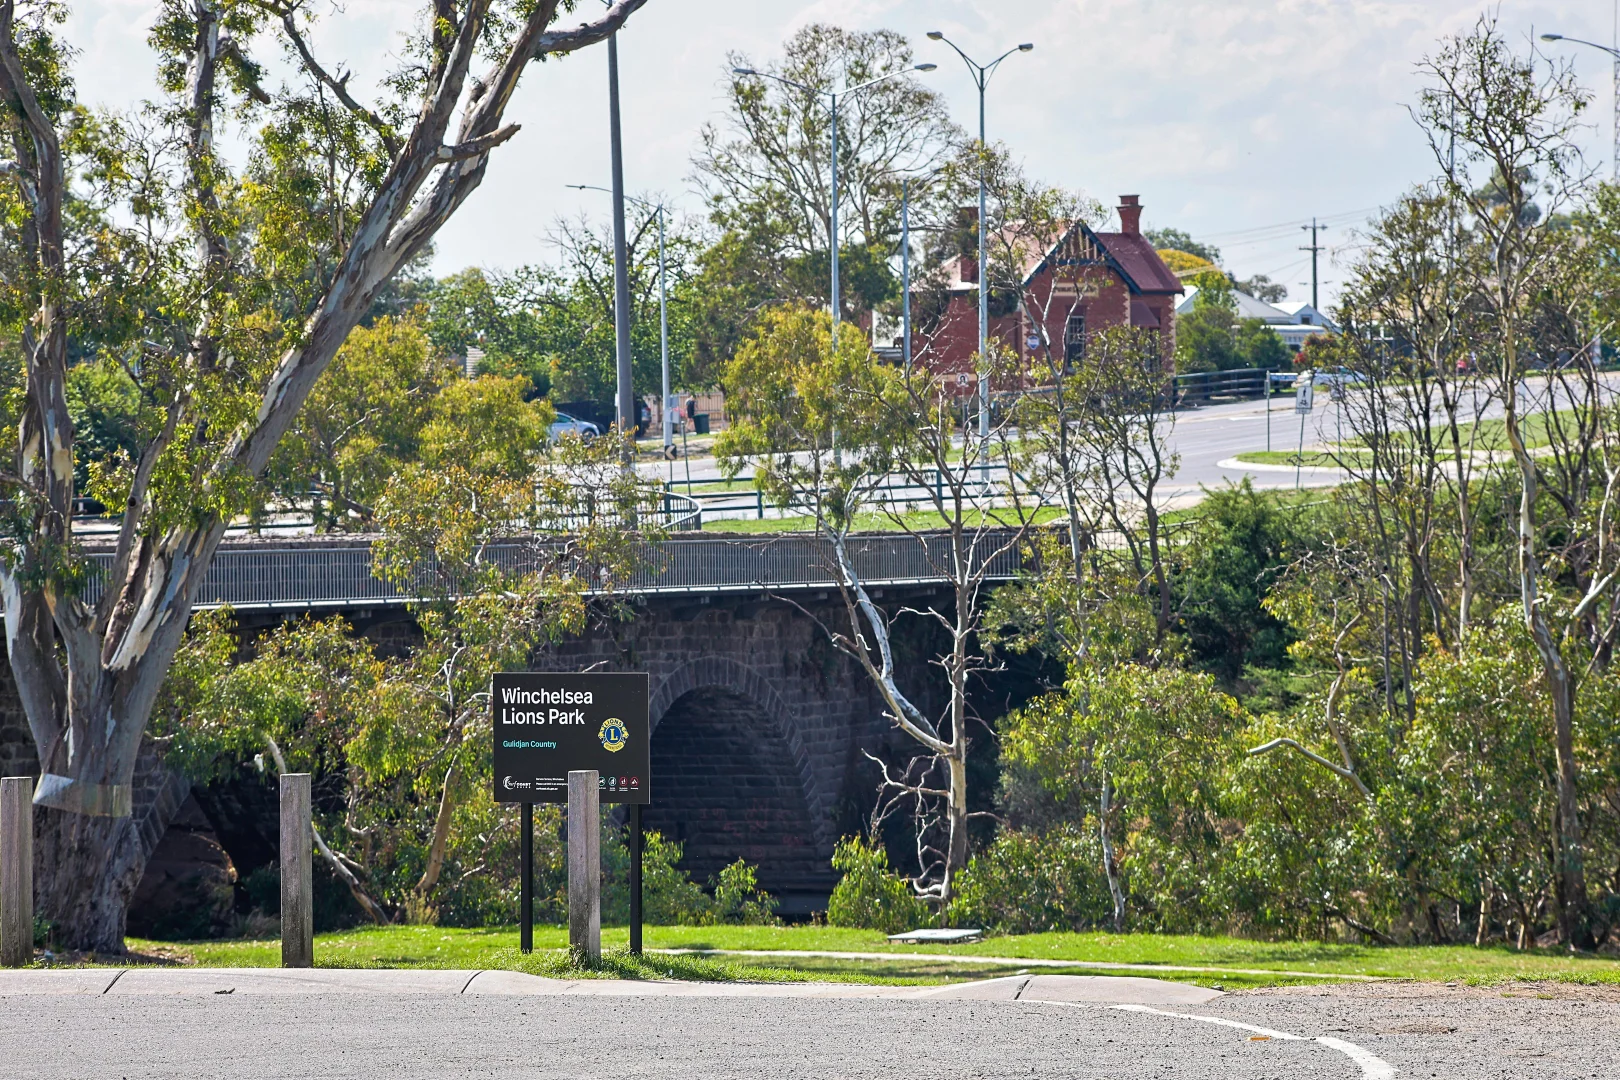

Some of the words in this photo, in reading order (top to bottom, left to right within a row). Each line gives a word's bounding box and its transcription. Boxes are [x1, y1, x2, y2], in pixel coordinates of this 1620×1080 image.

[502, 687, 593, 704] Winchelsea
[502, 707, 545, 724] Lions
[548, 707, 585, 724] Park
[604, 718, 622, 726] LIONS
[610, 728, 618, 741] L
[502, 739, 529, 749] Gulidjan
[530, 739, 557, 749] Country
